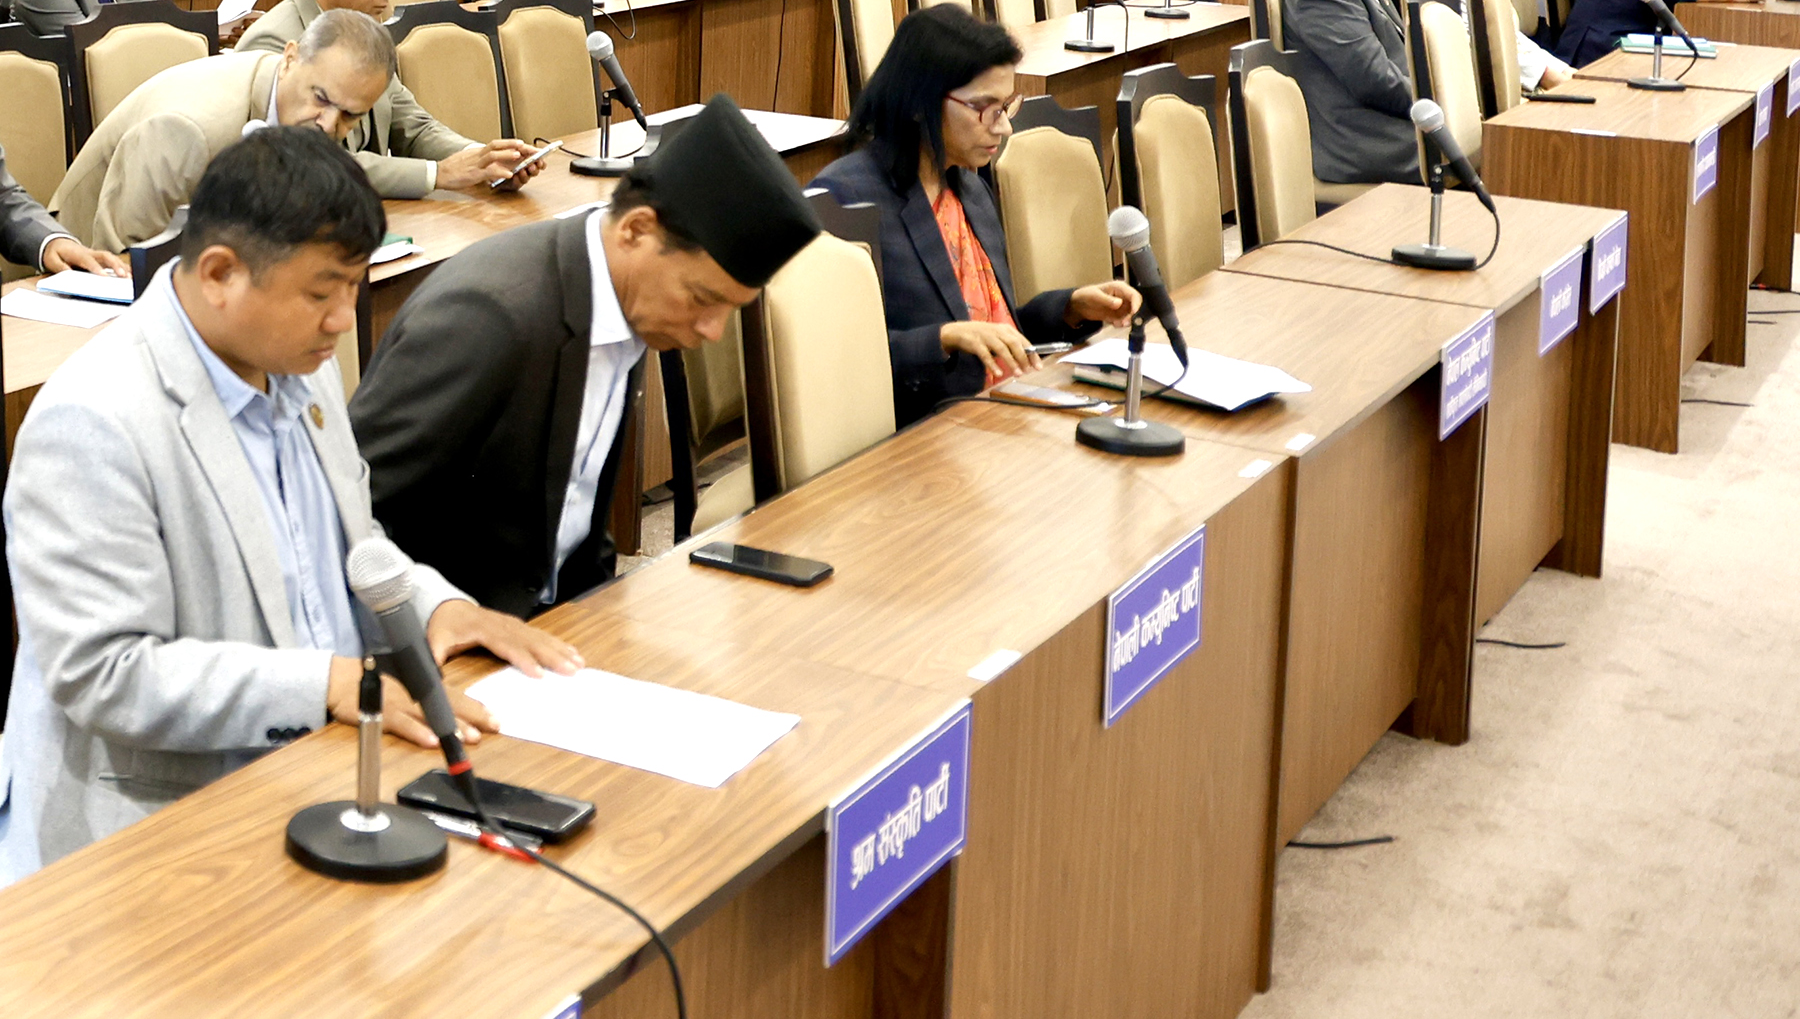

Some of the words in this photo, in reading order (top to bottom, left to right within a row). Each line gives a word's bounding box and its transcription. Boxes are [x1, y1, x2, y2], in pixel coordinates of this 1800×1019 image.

[1181, 567, 1199, 614] पार्टी
[851, 832, 877, 890] श्रम
[877, 784, 923, 865] संस्कृति
[924, 763, 950, 822] पार्टी
